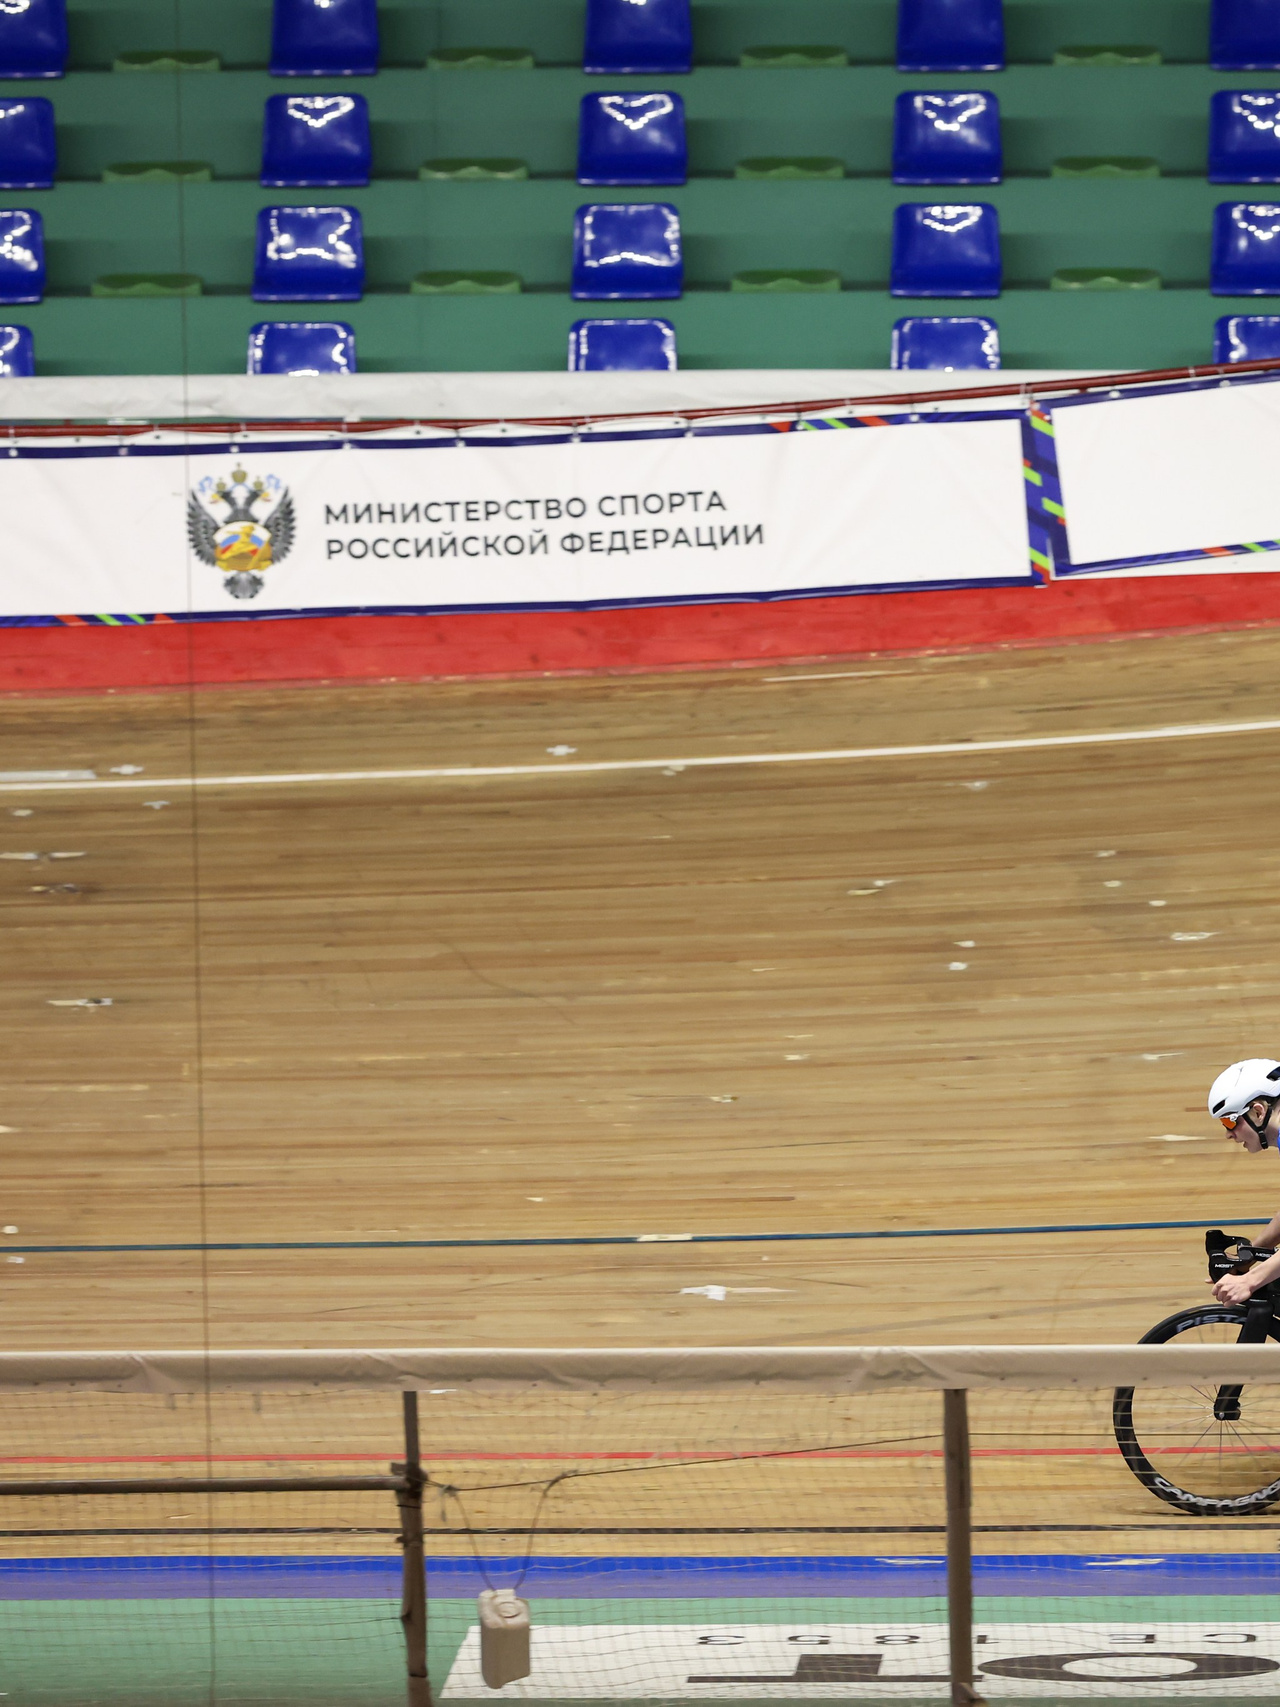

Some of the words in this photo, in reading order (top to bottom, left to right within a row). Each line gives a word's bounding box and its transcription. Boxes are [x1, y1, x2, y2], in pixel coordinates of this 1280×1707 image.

[323, 497, 587, 525] МИНИСТЕРСТВО
[597, 490, 727, 518] СПОРТА
[326, 529, 550, 561] РОССИЙСКОЙ
[560, 523, 765, 556] ФЕДЕРАЦИИ
